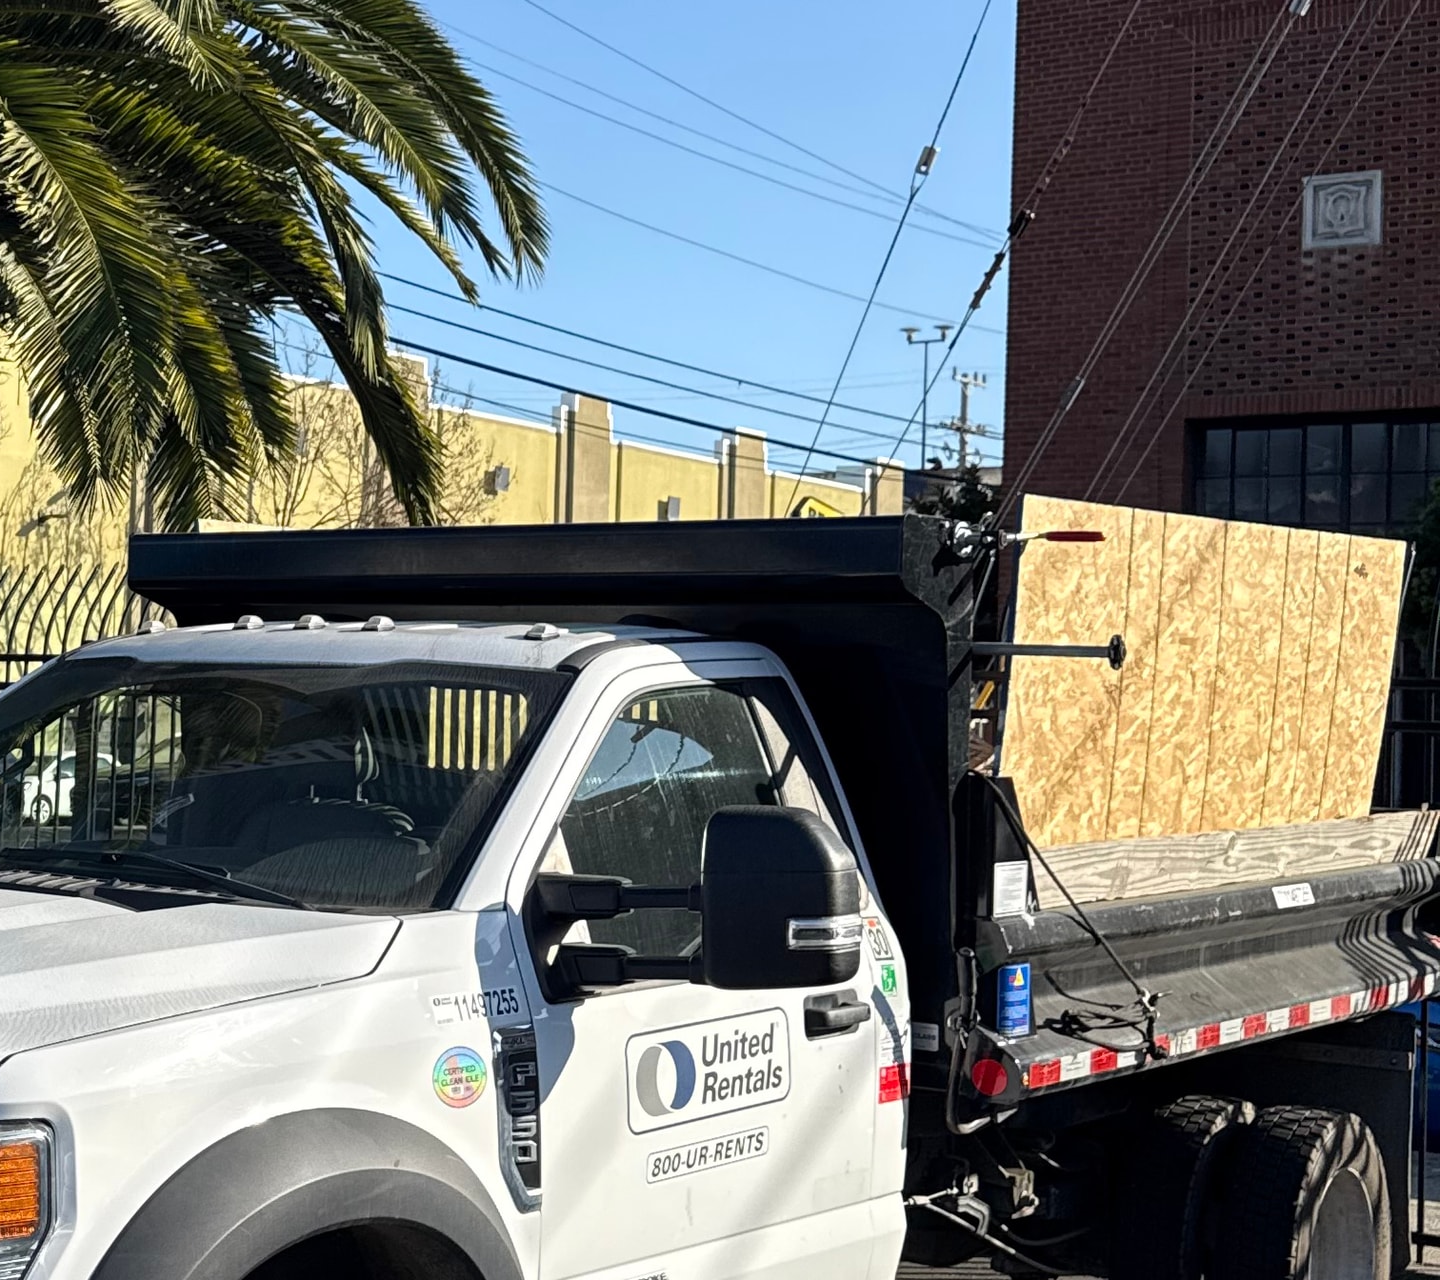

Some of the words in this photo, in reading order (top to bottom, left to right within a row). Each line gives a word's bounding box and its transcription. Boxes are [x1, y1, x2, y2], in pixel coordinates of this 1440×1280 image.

[868, 928, 889, 956] 30
[454, 987, 519, 1022] 11497255
[702, 1022, 775, 1067] United
[441, 1077, 462, 1087] CLEAN
[702, 1059, 783, 1104] Rentals
[651, 1131, 765, 1178] 800-UR-RENTS
